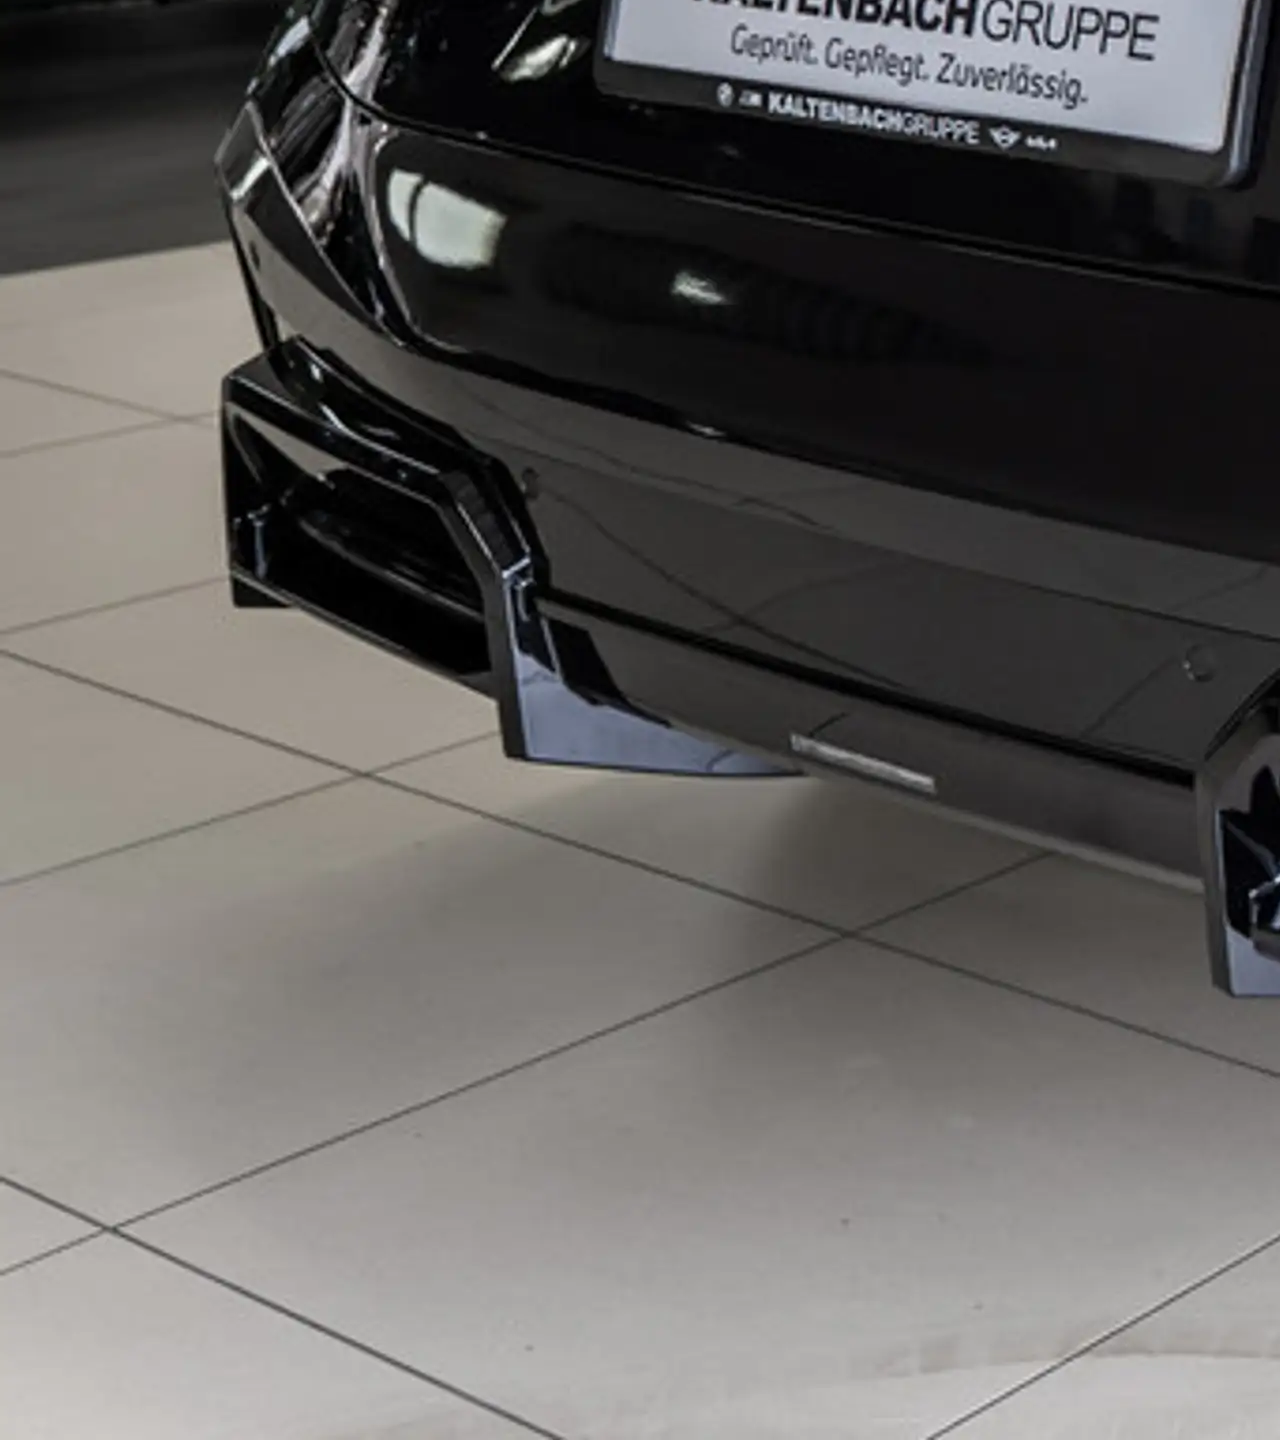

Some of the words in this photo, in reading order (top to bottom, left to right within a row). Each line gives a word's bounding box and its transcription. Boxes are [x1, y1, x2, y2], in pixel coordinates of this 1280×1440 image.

[731, 22, 820, 64] Geprüft.
[824, 36, 929, 86] Gepflegt.
[935, 51, 1089, 110] Zuverlässig.
